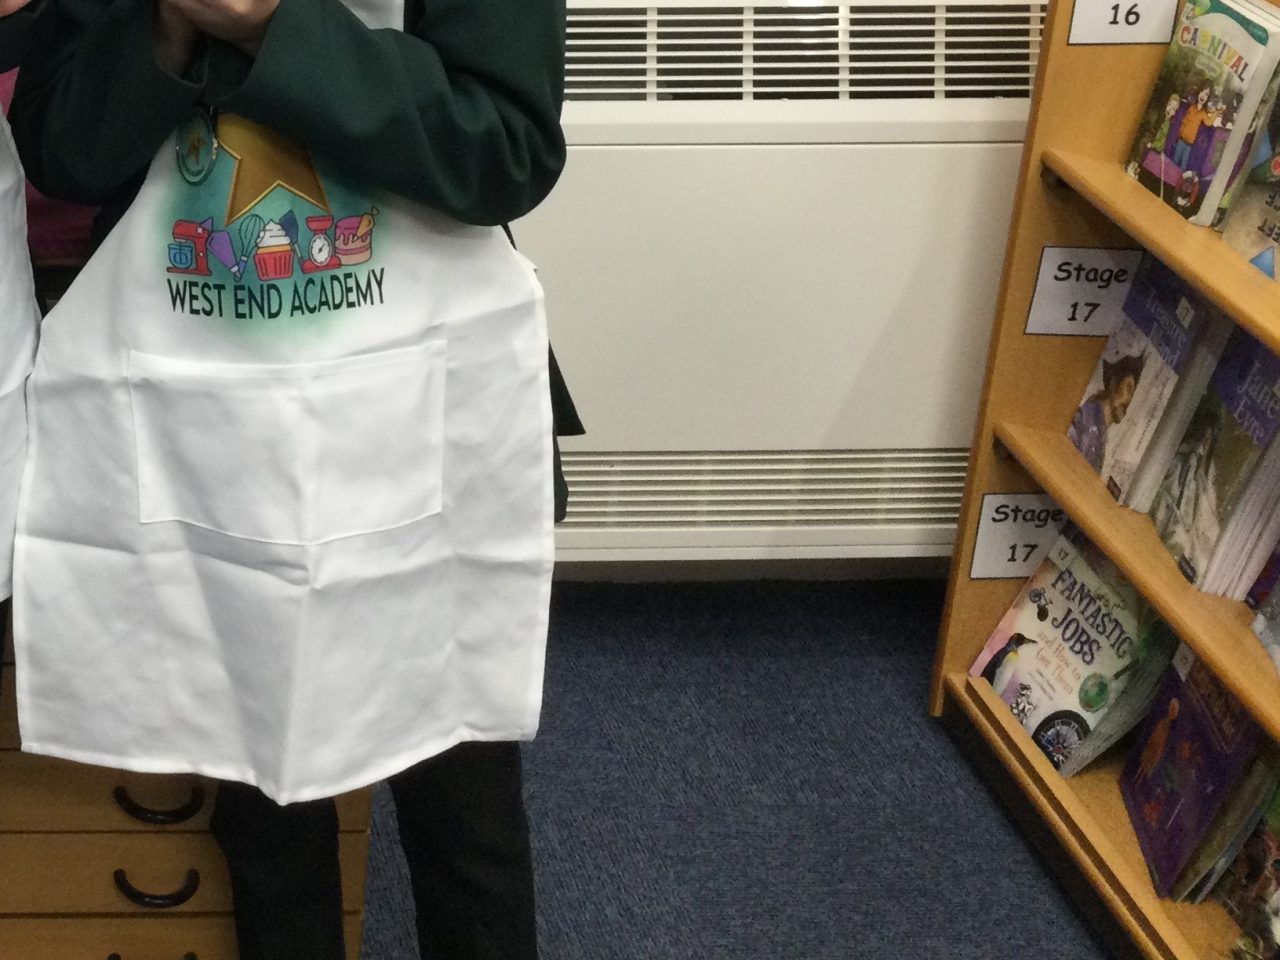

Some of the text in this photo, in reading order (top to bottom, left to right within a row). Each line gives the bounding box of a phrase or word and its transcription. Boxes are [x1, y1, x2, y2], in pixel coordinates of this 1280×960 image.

[1108, 3, 1141, 26] 16
[1180, 25, 1249, 83] CARNIVAL
[1053, 261, 1129, 287] Stage
[166, 267, 385, 320] WEST END ACADEMY
[1066, 301, 1101, 323] 17
[991, 504, 1064, 529] Stage
[1007, 543, 1039, 563] 17
[1051, 568, 1135, 660] FANTASTIC
[1051, 608, 1102, 665] JOBS
